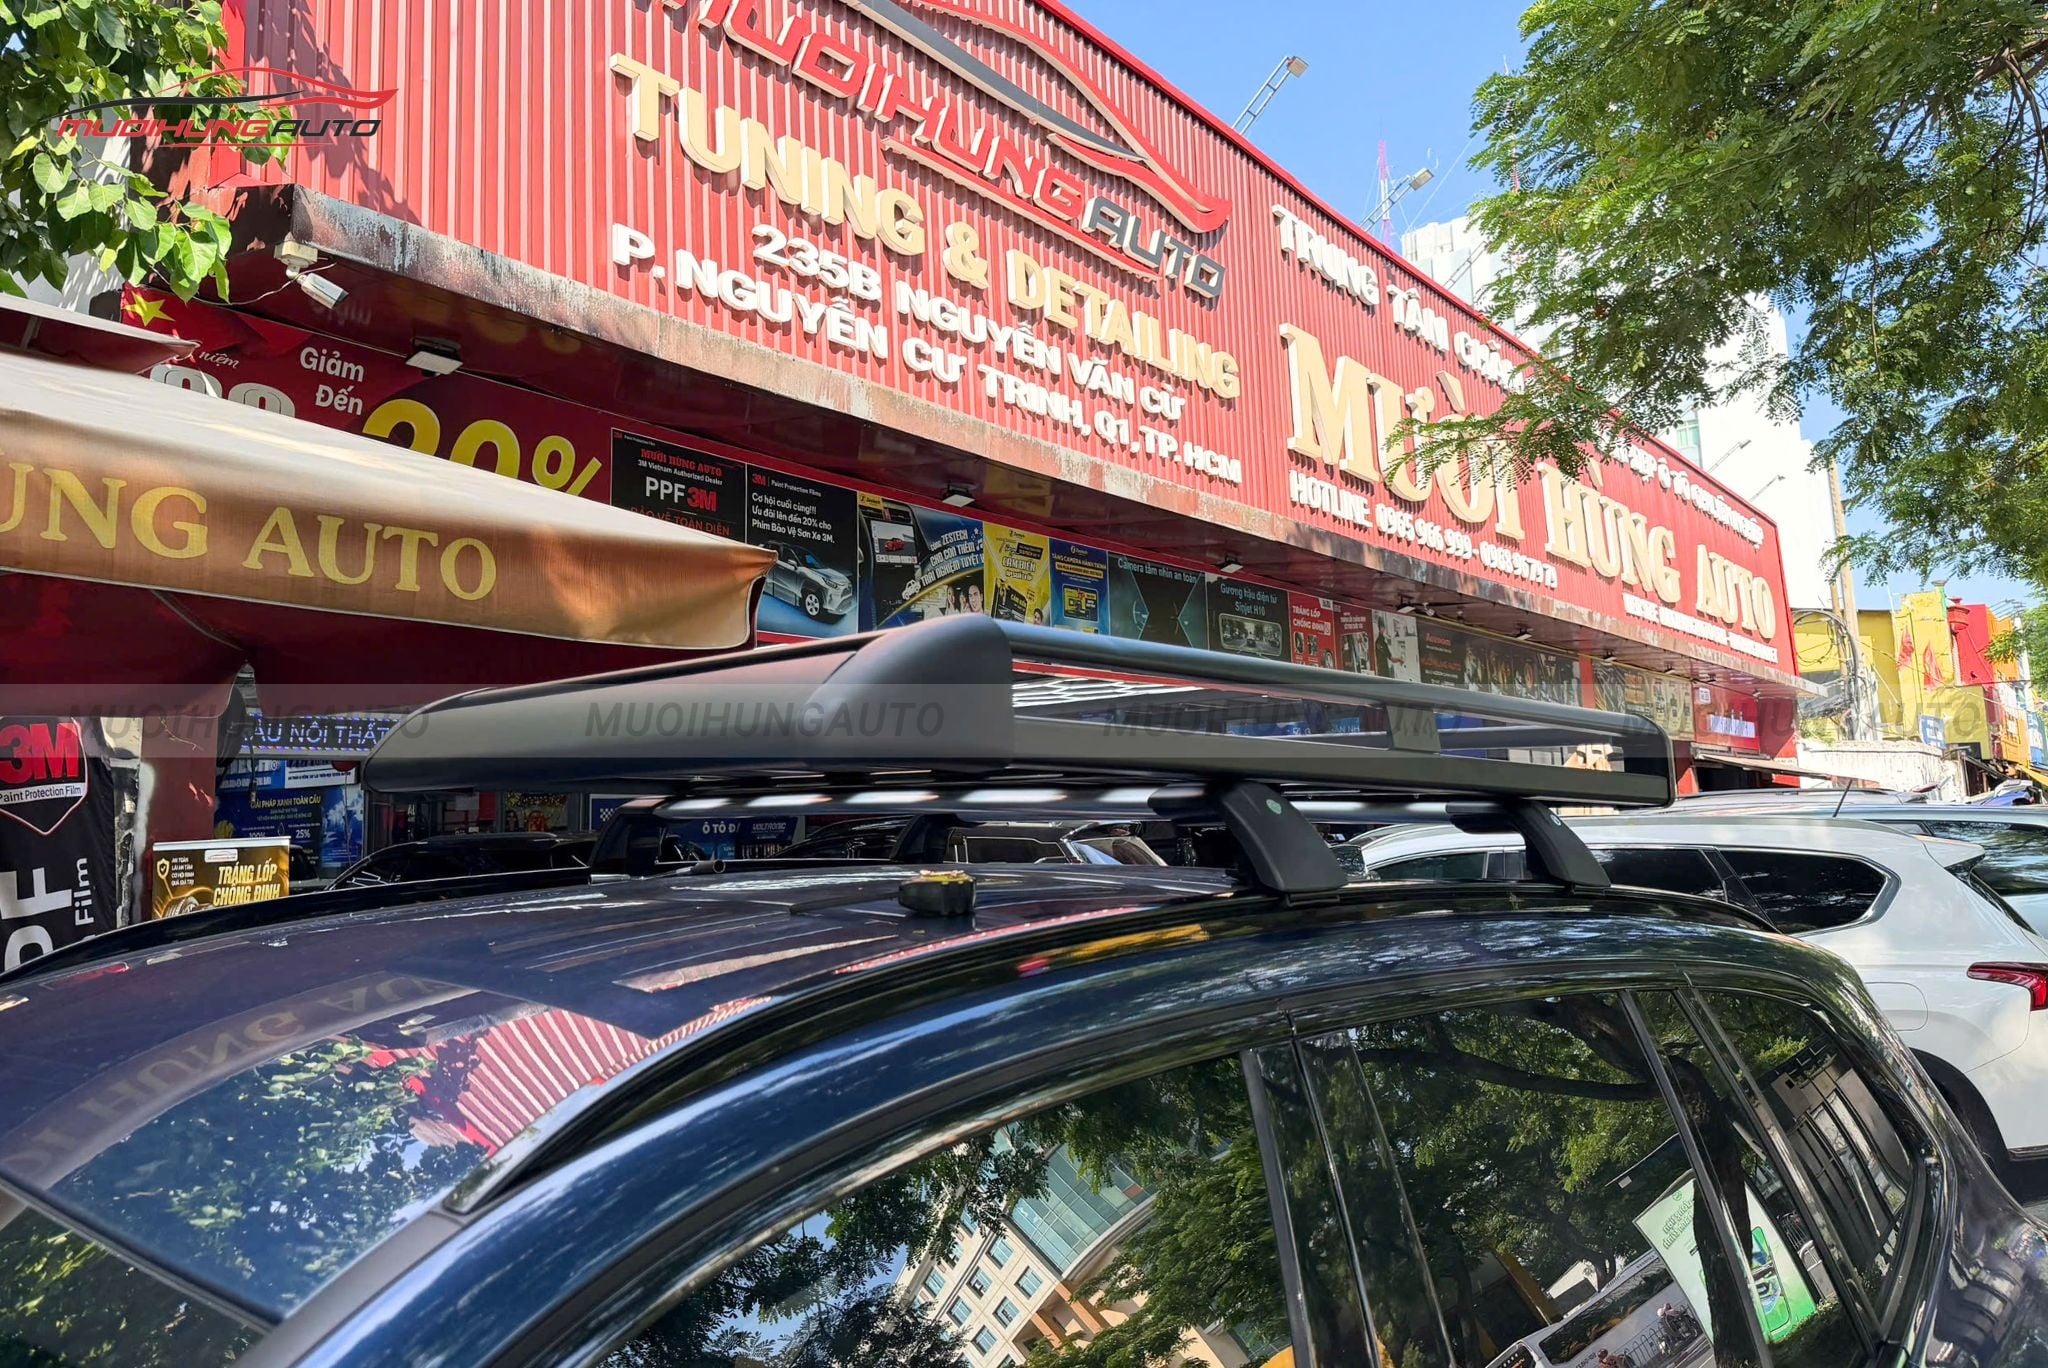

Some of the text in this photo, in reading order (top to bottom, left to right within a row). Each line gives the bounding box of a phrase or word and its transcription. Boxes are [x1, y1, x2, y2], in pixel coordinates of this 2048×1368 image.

[660, 0, 1226, 299] UOIHUNGAUTO
[609, 52, 1241, 399] TUNING & DETAILING
[1272, 204, 1379, 305] TRUNG
[1387, 284, 1449, 352] TÂM
[752, 224, 1185, 421] 235B NGUYỄN VĂN CỪ
[300, 347, 364, 382] Giảm
[903, 336, 967, 384] CƯ
[315, 384, 363, 415] Đến
[638, 459, 723, 486] 3M Vietnam Authorized Dealer
[697, 462, 723, 477] AUTO
[752, 473, 767, 487] 3M
[645, 476, 718, 512] PPF 3M
[752, 492, 817, 516] Cơ hội cuối cùng!!!
[1289, 470, 1373, 528] HOTLINE
[752, 503, 762, 516] Ưu
[776, 511, 788, 522] lên
[788, 512, 802, 525] đến
[802, 517, 818, 529] 20%
[818, 520, 832, 531] cho
[752, 519, 771, 531] Phim
[771, 520, 787, 535] Bảo
[787, 523, 797, 538] Vệ
[811, 531, 822, 541] Xe
[822, 532, 836, 544] 3M.
[241, 506, 497, 601] AUTO
[1537, 457, 1682, 604] HÙNG
[1696, 543, 1776, 640] AUTO
[1118, 557, 1144, 573] Camera
[1174, 572, 1182, 581] an
[1220, 583, 1243, 599] Gương
[0, 723, 79, 784] 3M
[25, 785, 64, 799] Protection
[65, 784, 82, 797] Film
[295, 829, 310, 839] 25%
[702, 821, 710, 834] Ô
[712, 820, 726, 834] TÔ
[218, 858, 278, 885] TRÁNG LỐP
[74, 857, 95, 926] Film
